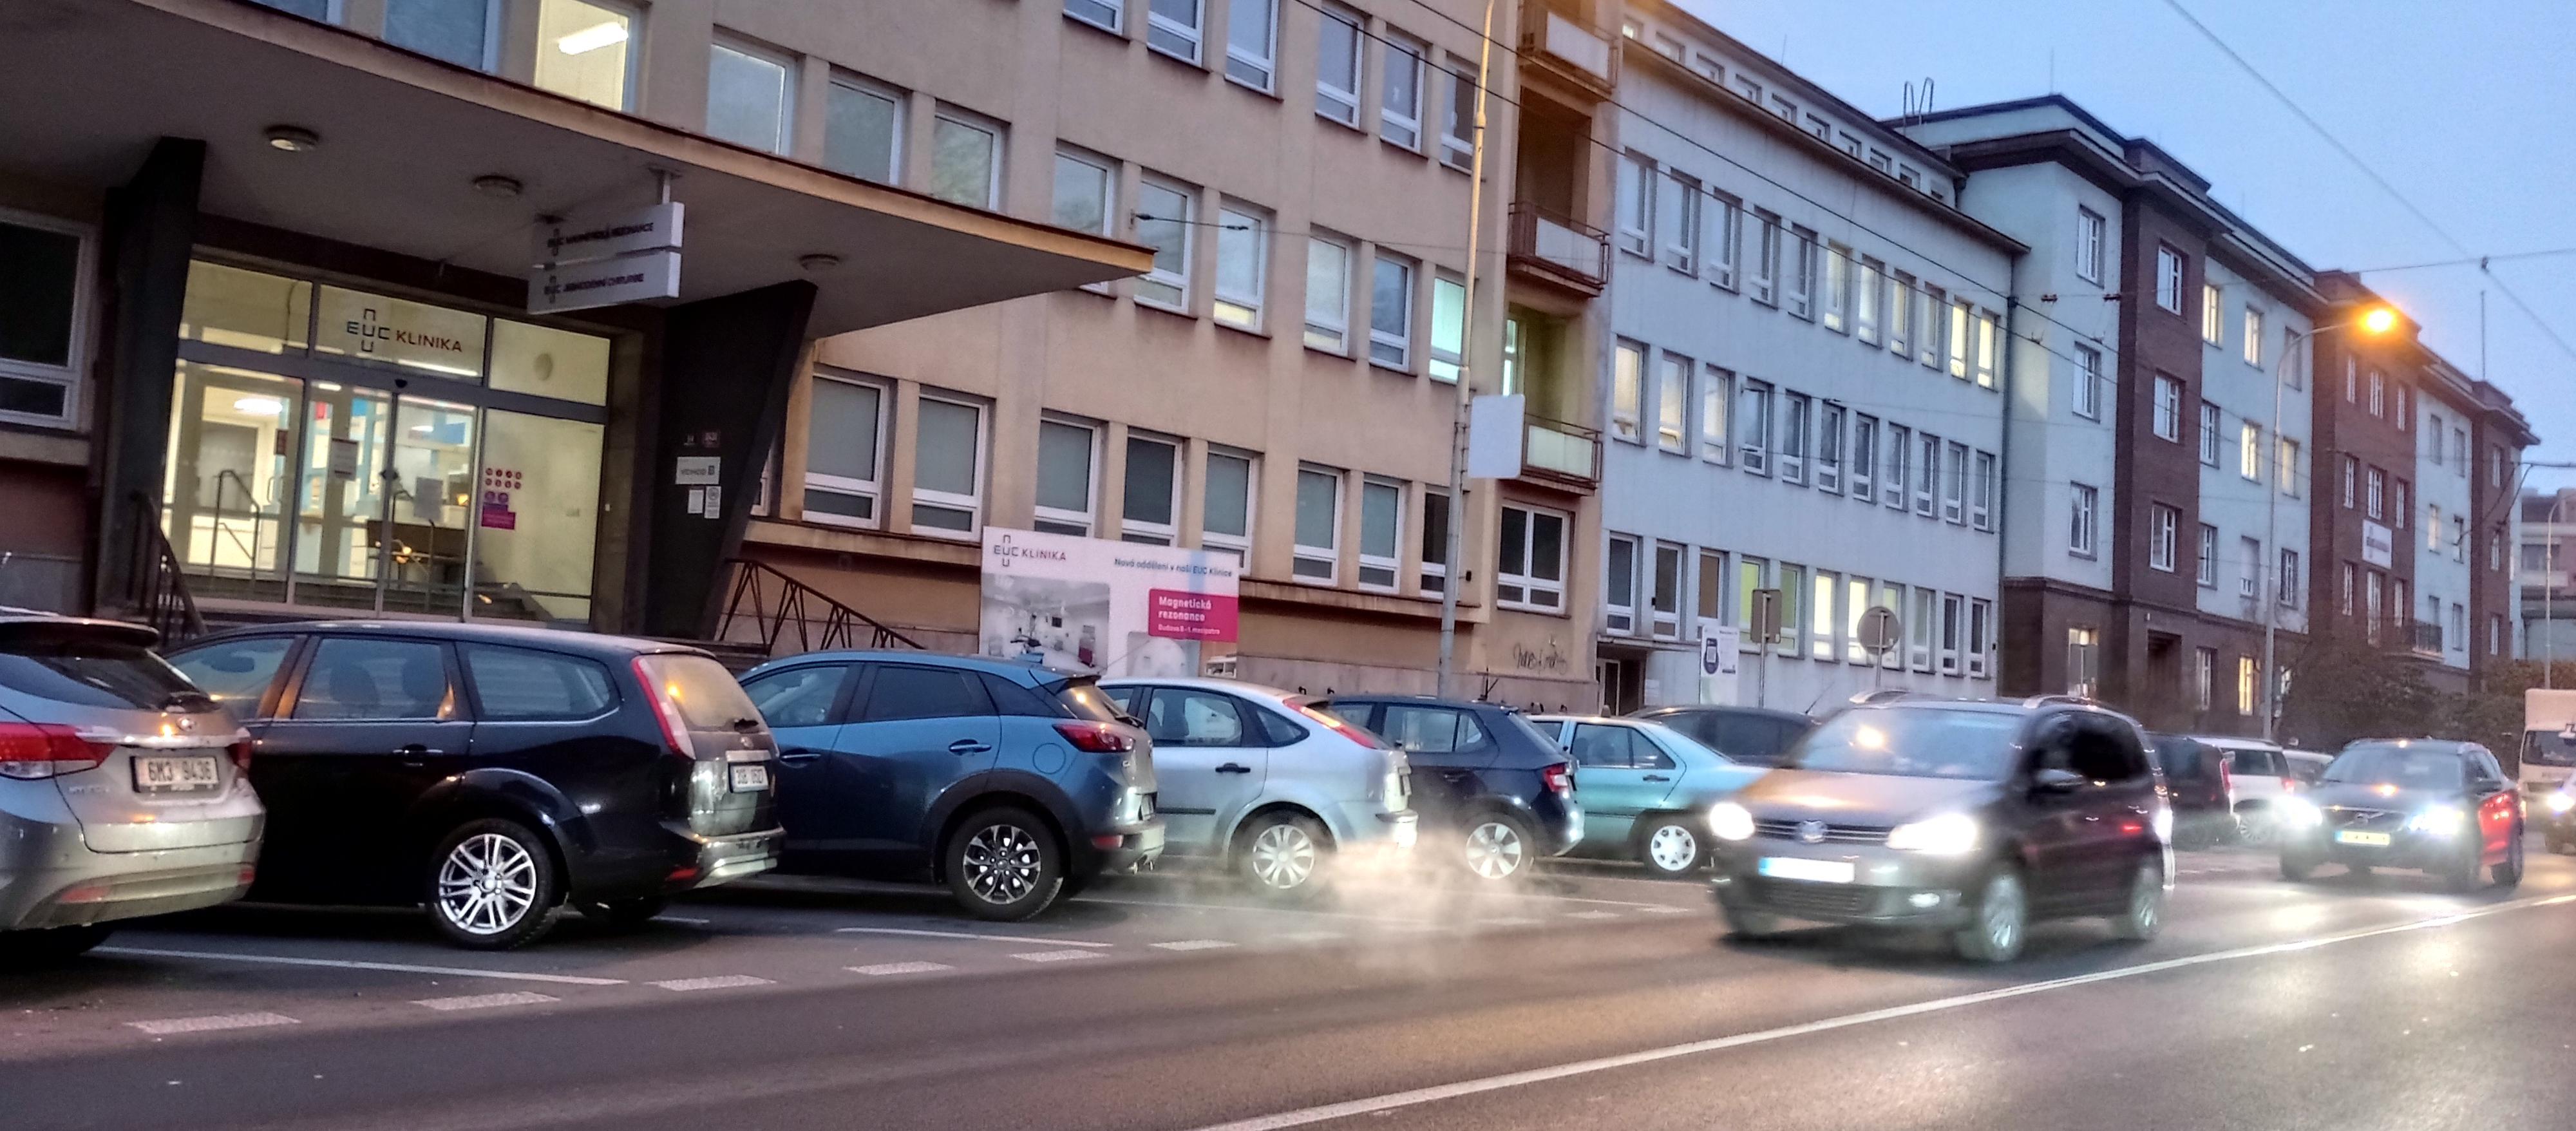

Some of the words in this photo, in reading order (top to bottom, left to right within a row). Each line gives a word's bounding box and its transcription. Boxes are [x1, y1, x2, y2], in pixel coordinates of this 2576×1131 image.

[396, 330, 462, 353] KLINIKA
[1021, 547, 1066, 561] KLINIKA
[1193, 566, 1208, 575] EUC
[1159, 596, 1212, 611] Magnetická
[1158, 611, 1206, 622] rezonance
[148, 761, 173, 782] 6M3
